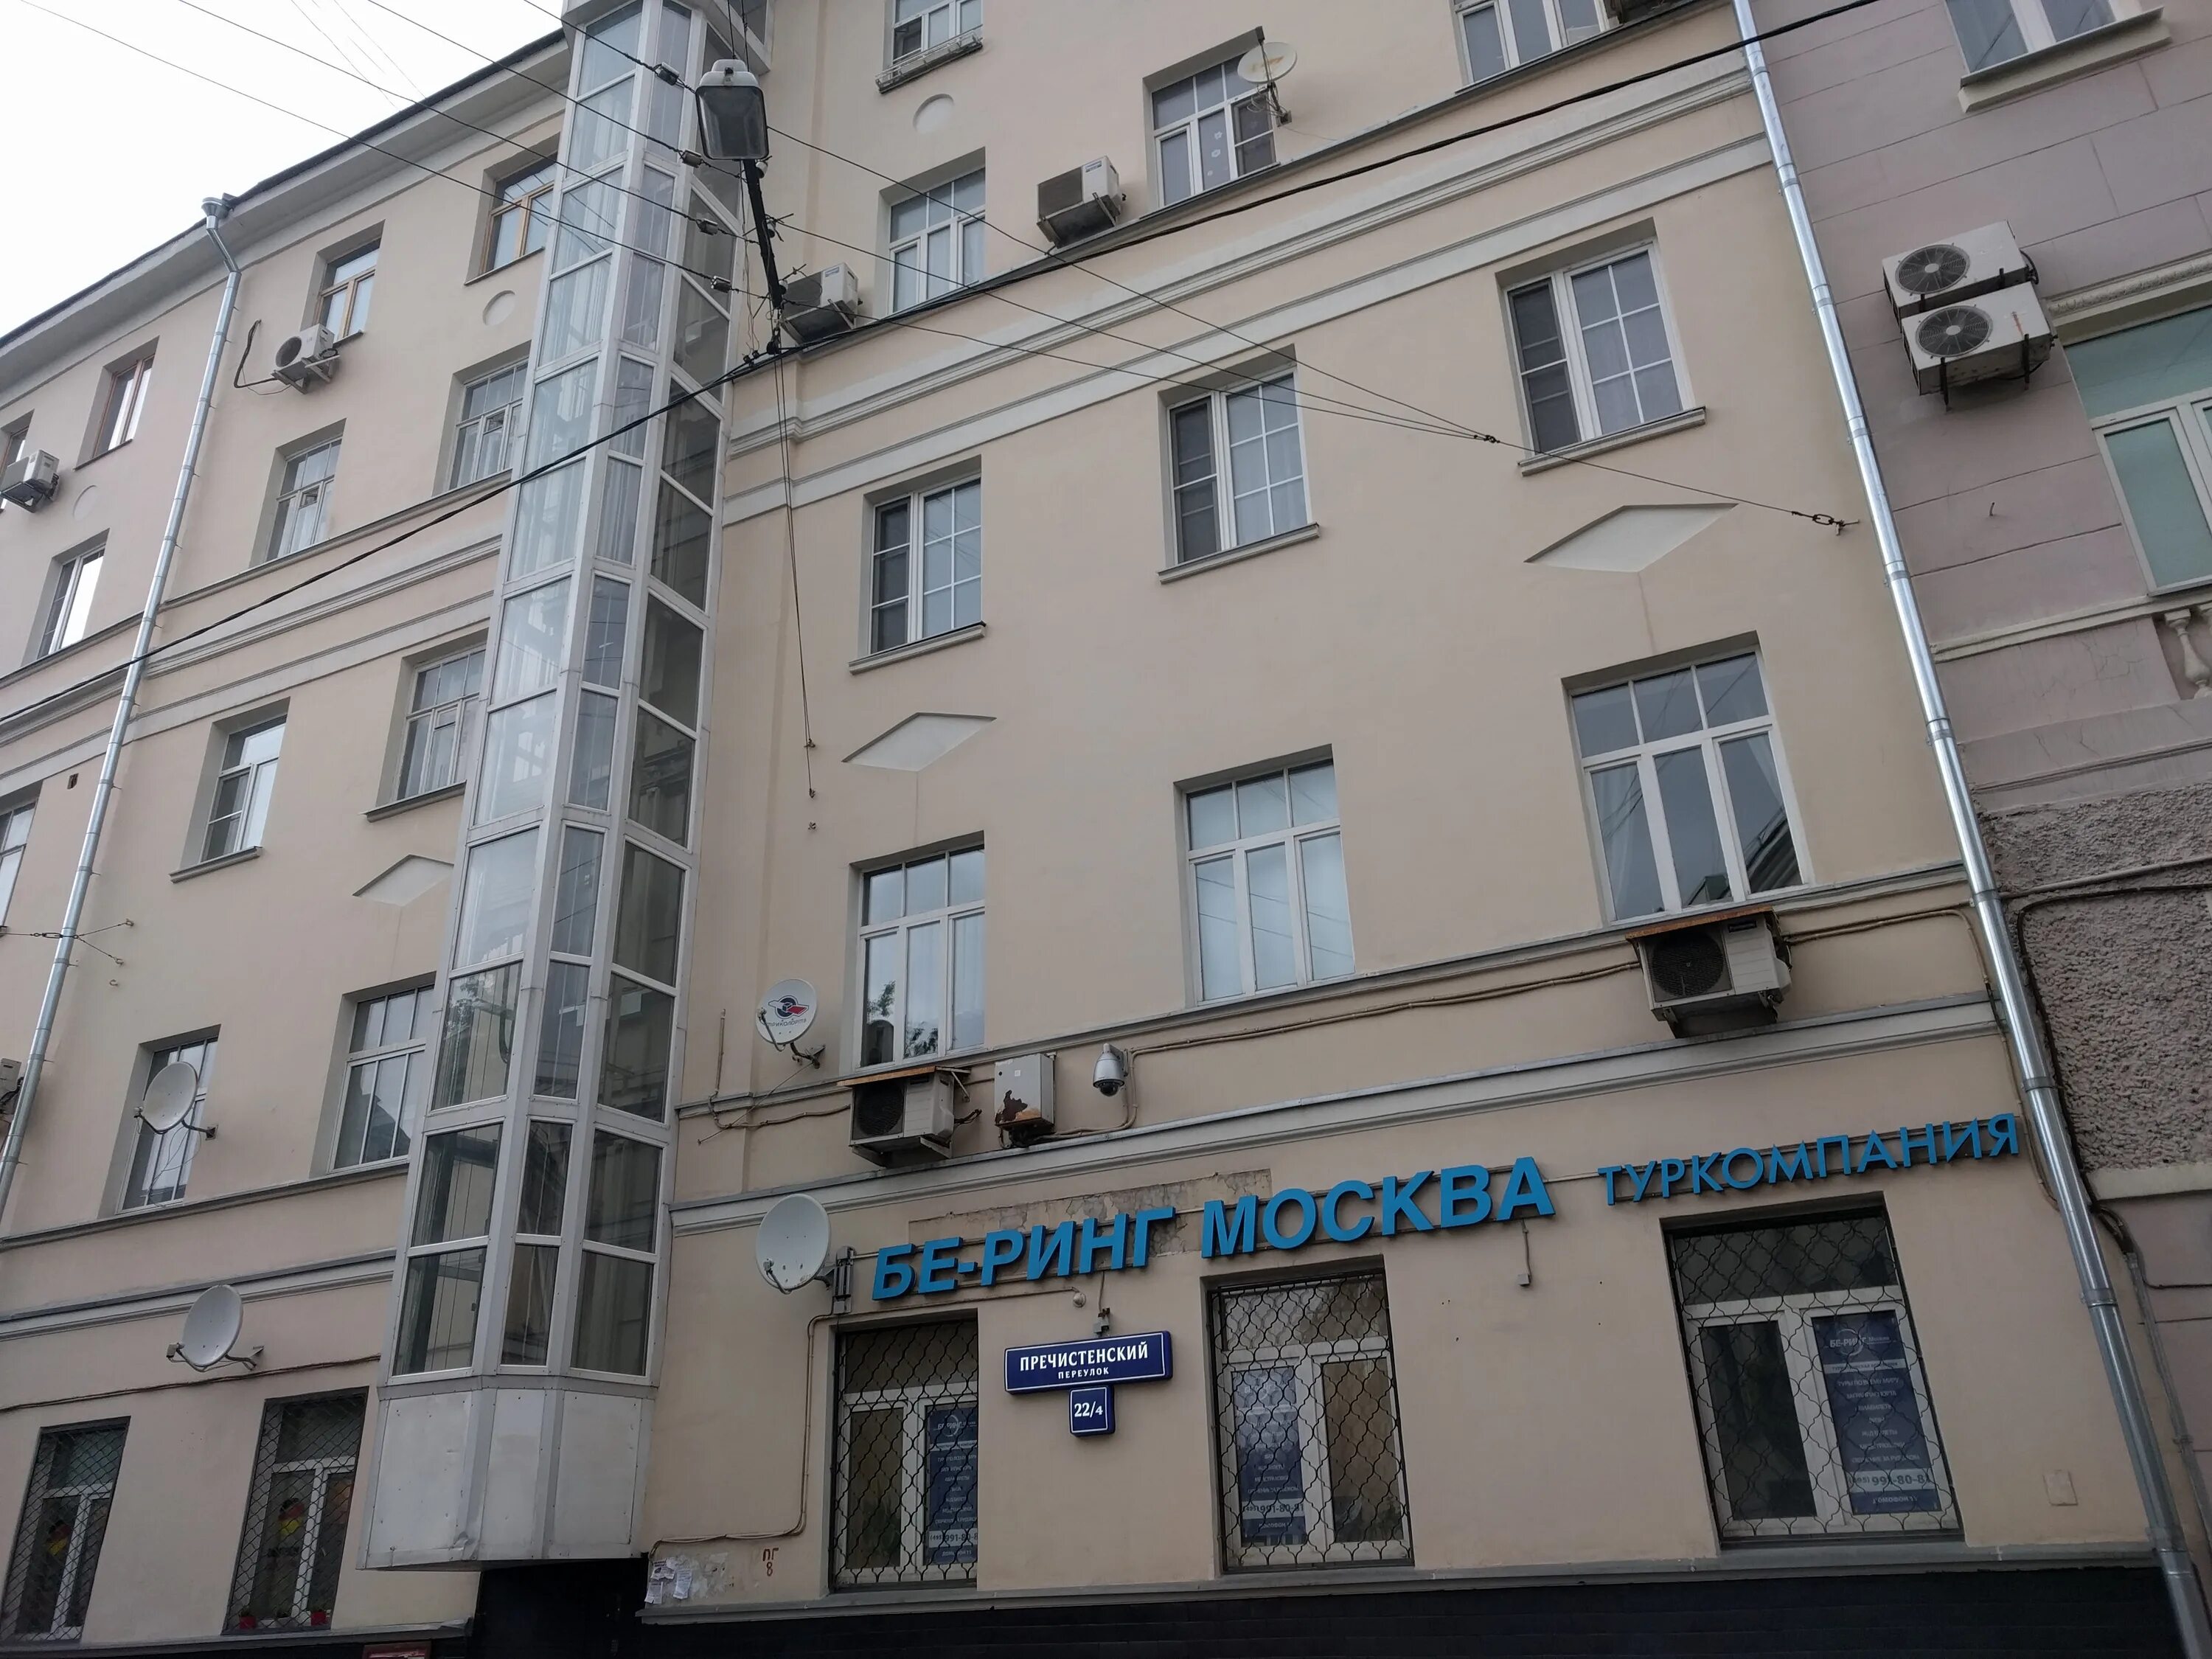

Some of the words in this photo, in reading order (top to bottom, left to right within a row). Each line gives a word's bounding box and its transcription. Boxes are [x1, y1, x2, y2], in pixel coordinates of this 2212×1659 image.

[1598, 1112, 2019, 1206] ТУРКОМПАНИЯ
[872, 1206, 1175, 1301] БЕ-РИНГ
[1201, 1155, 1557, 1259] МОСКВА
[1019, 1340, 1149, 1371] ПРЕЧИСТЕНСКИЙ
[1057, 1366, 1110, 1380] ПЕРЕУЛОК
[1074, 1400, 1104, 1418] 22/4
[767, 1562, 773, 1576] 8
